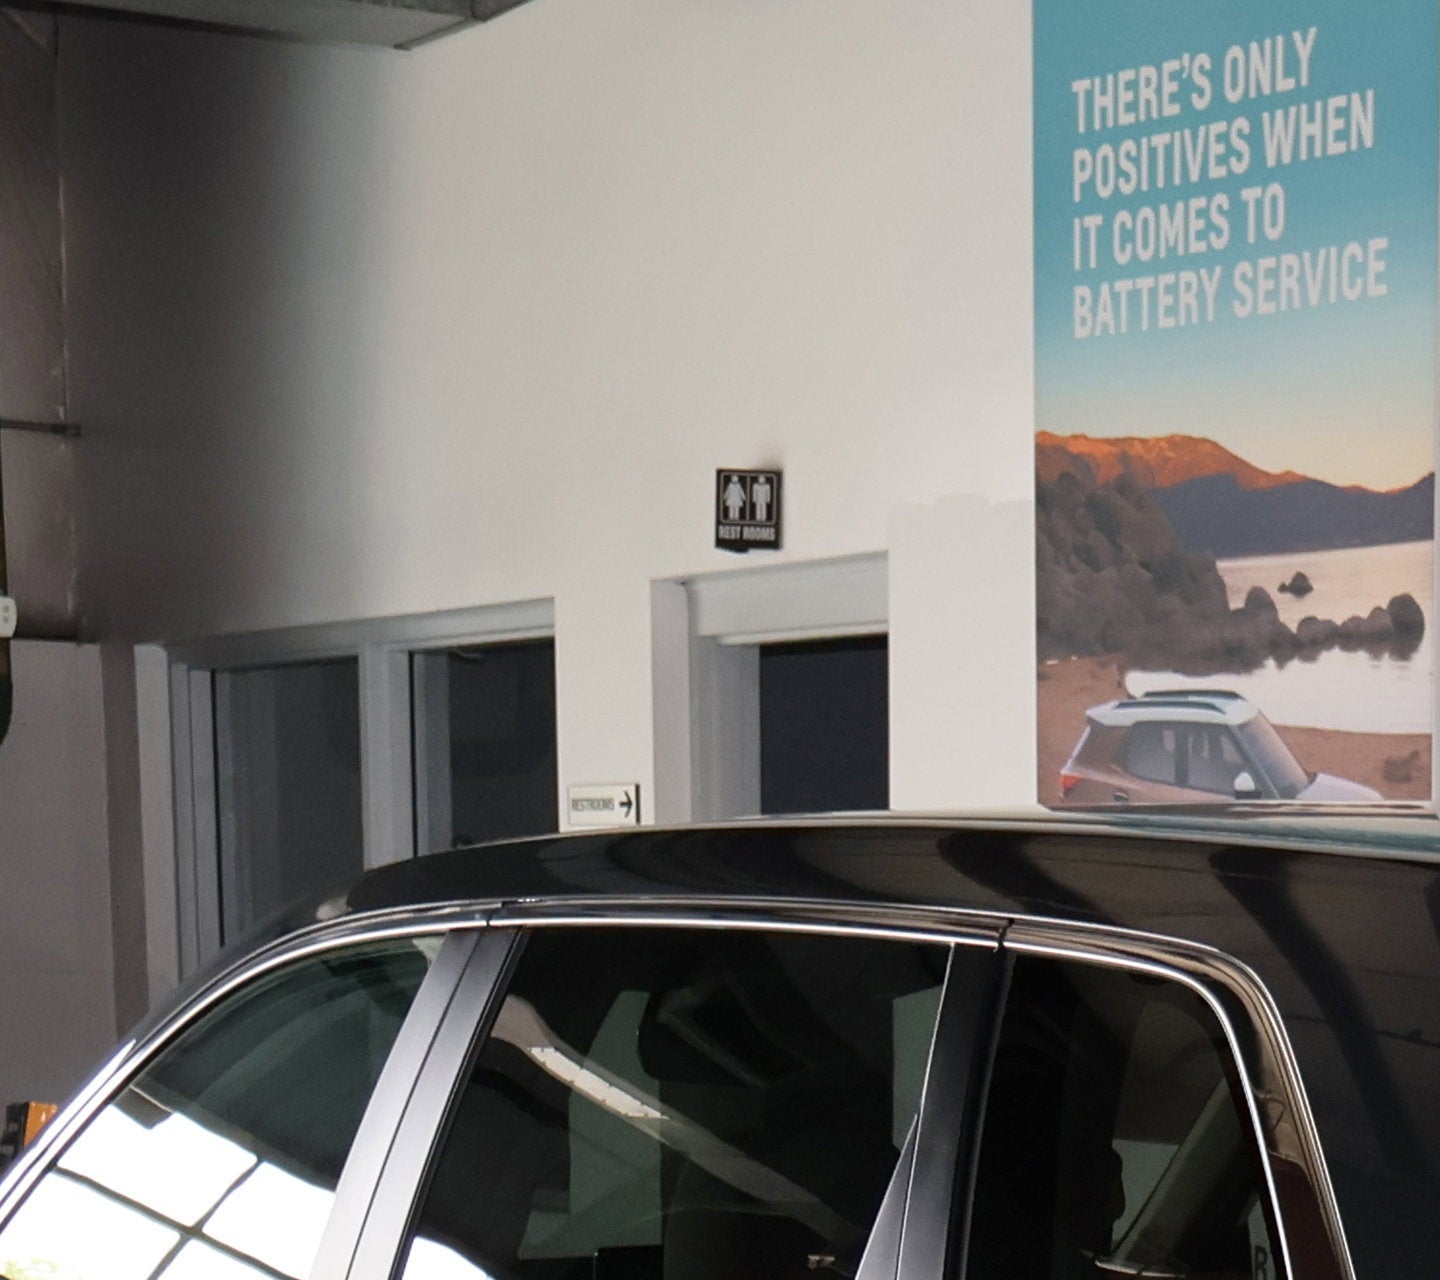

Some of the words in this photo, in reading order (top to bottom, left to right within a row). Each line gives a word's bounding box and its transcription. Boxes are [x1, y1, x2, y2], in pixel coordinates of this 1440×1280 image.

[1071, 53, 1212, 133] THERE'S
[1223, 26, 1317, 102] ONLY
[1073, 116, 1250, 202] POSITIVES
[1262, 89, 1375, 168] WHEN
[1073, 214, 1102, 270] IT
[1112, 193, 1230, 266] COMES
[1240, 182, 1285, 243] TO
[1073, 265, 1221, 339] BATTERY
[1232, 237, 1388, 318] SERVICE
[719, 525, 741, 540] REST
[742, 526, 776, 541] ROOMS
